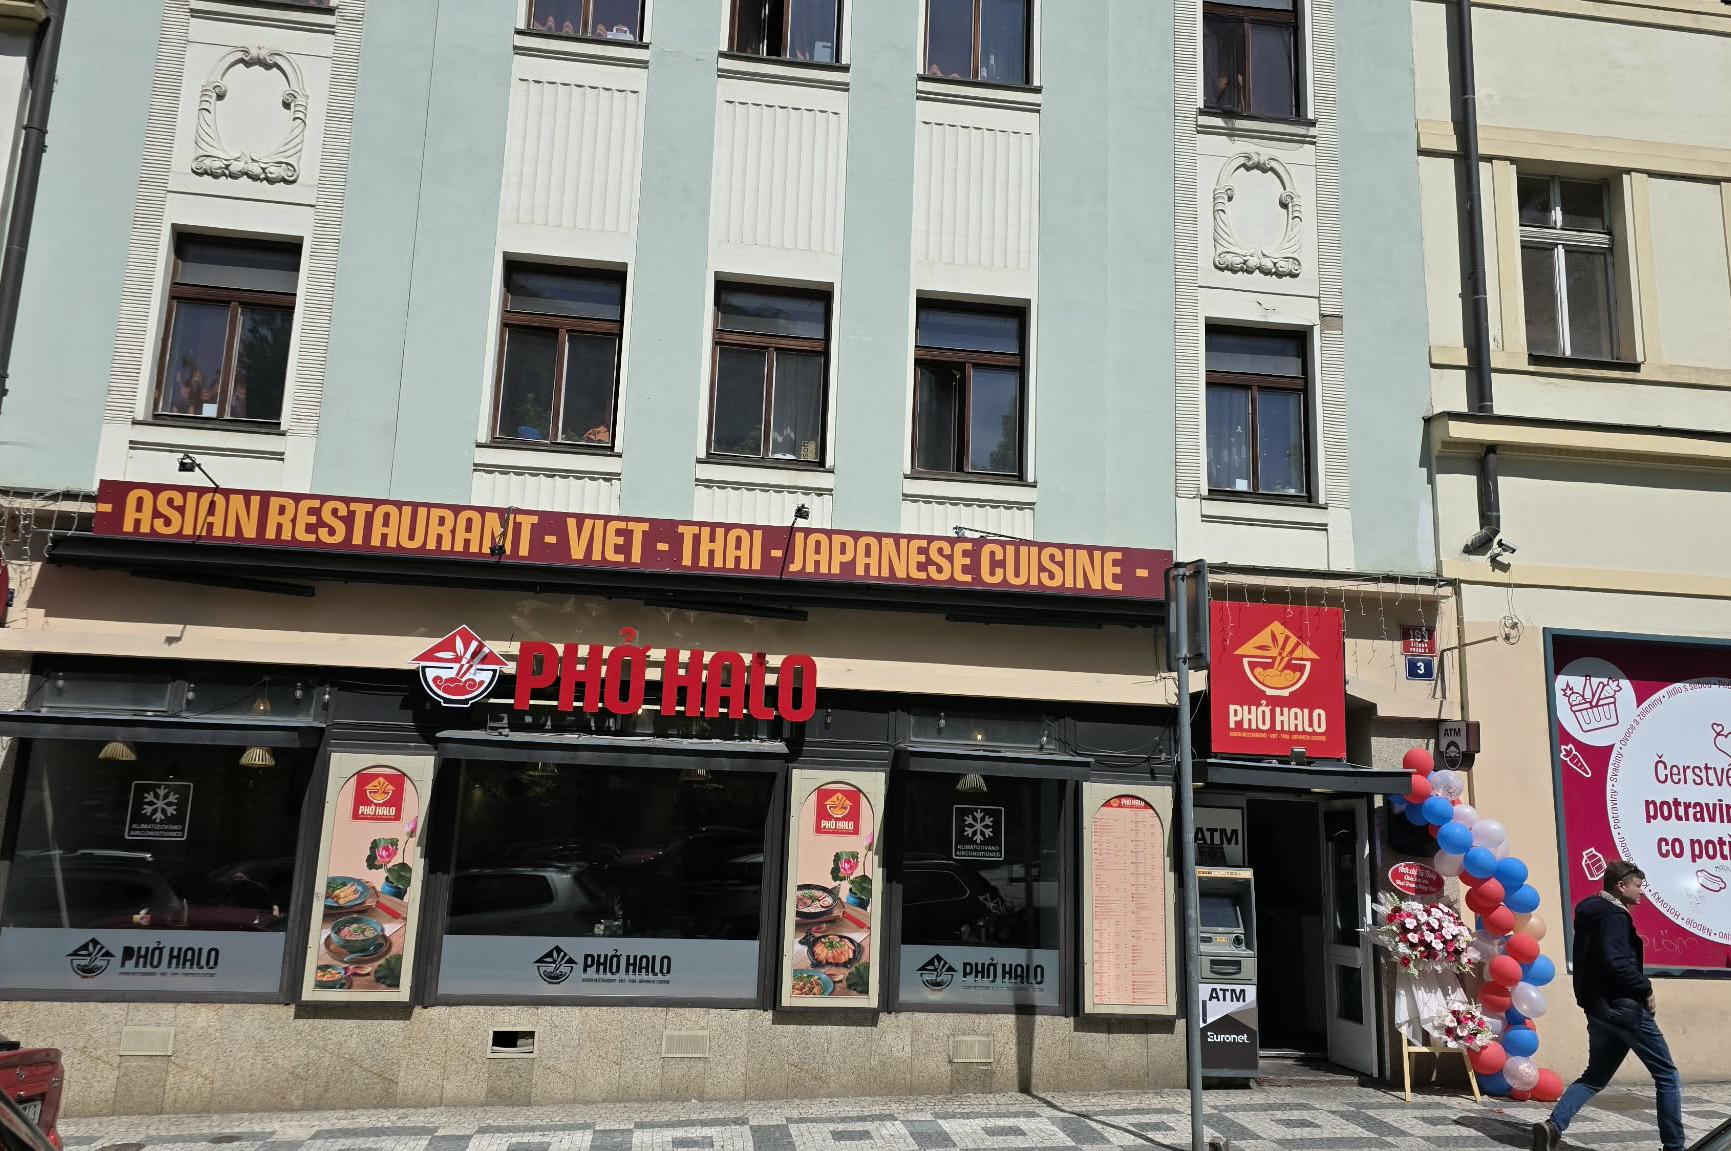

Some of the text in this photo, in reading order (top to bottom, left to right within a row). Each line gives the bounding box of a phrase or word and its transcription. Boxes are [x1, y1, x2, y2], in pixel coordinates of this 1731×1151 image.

[123, 489, 261, 540] ASIAN
[266, 497, 538, 557] RESTAURANT
[567, 518, 649, 564] VIET
[678, 526, 763, 571] THAI
[789, 532, 973, 583] JAPANESE
[981, 544, 1123, 591] CUISINE
[514, 626, 818, 723] PHỞ HALO
[1417, 661, 1425, 674] 3
[1229, 699, 1327, 733] PHỞ HALO
[1444, 727, 1461, 738] ATM
[375, 806, 396, 816] HALO
[836, 820, 854, 830] HALO
[1194, 827, 1240, 846] ATM
[1657, 834, 1731, 863] co pot
[120, 940, 220, 970] PHỞ HALO
[582, 948, 672, 977] PHỞ HALO
[962, 957, 1045, 985] PHỞ HALO
[1208, 987, 1247, 1003] ATM
